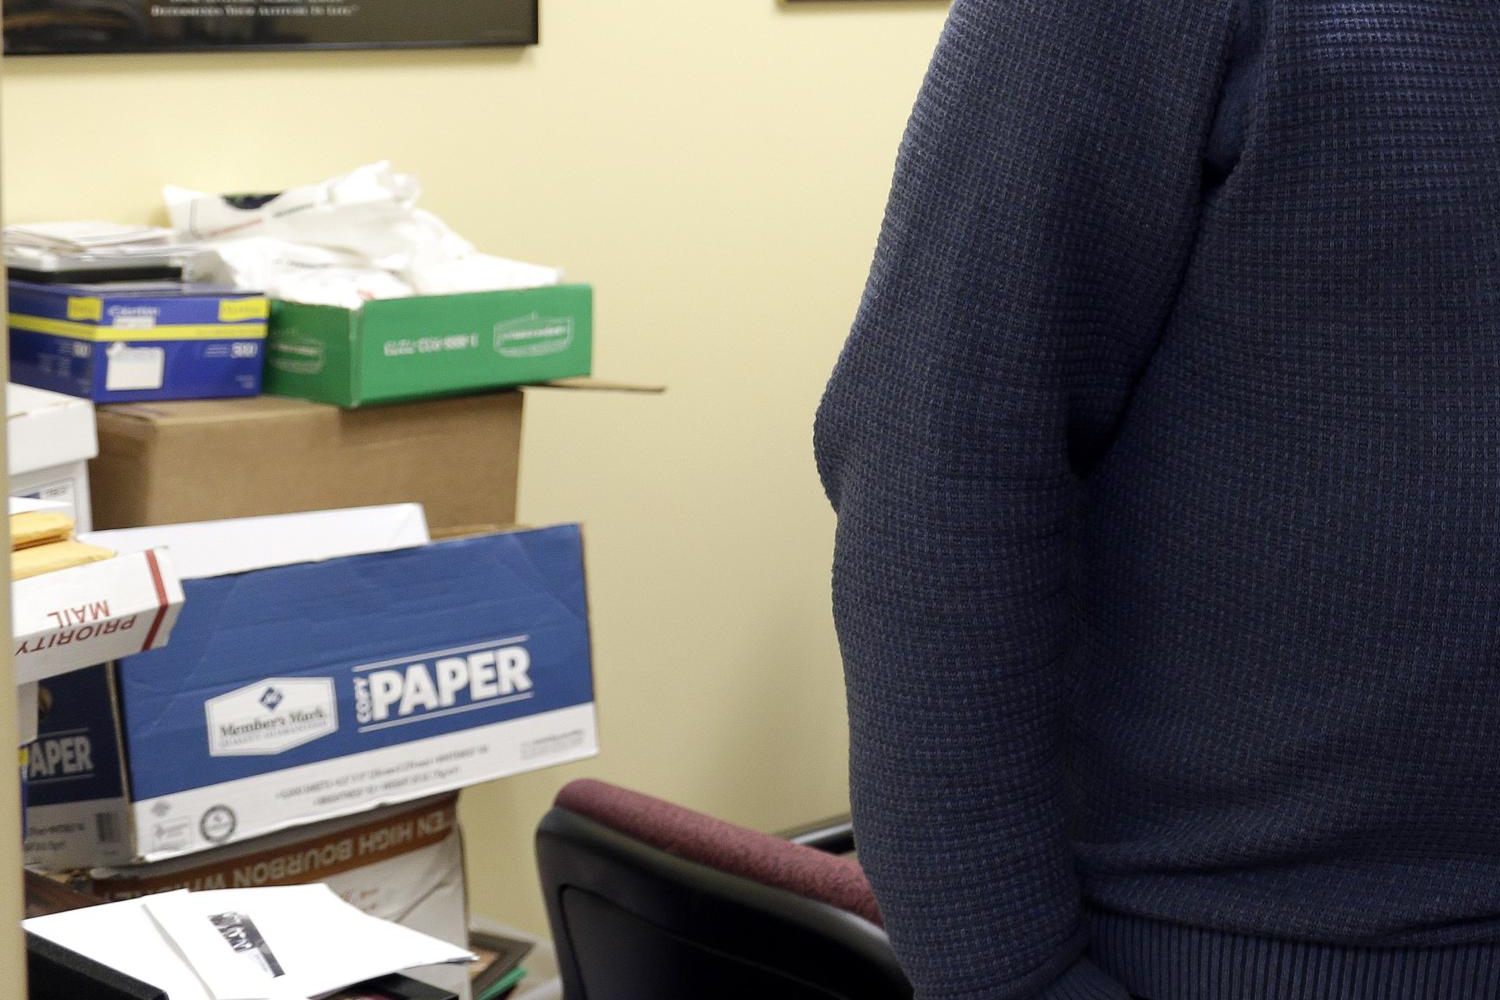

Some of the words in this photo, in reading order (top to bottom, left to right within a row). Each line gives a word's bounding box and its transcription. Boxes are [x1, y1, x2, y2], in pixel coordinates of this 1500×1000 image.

[47, 599, 110, 629] MAIL
[15, 615, 138, 657] PRIORITY
[369, 645, 534, 722] PAPER
[28, 735, 94, 779] APER
[358, 818, 412, 855] HIGH
[232, 838, 352, 889] BOURBON
